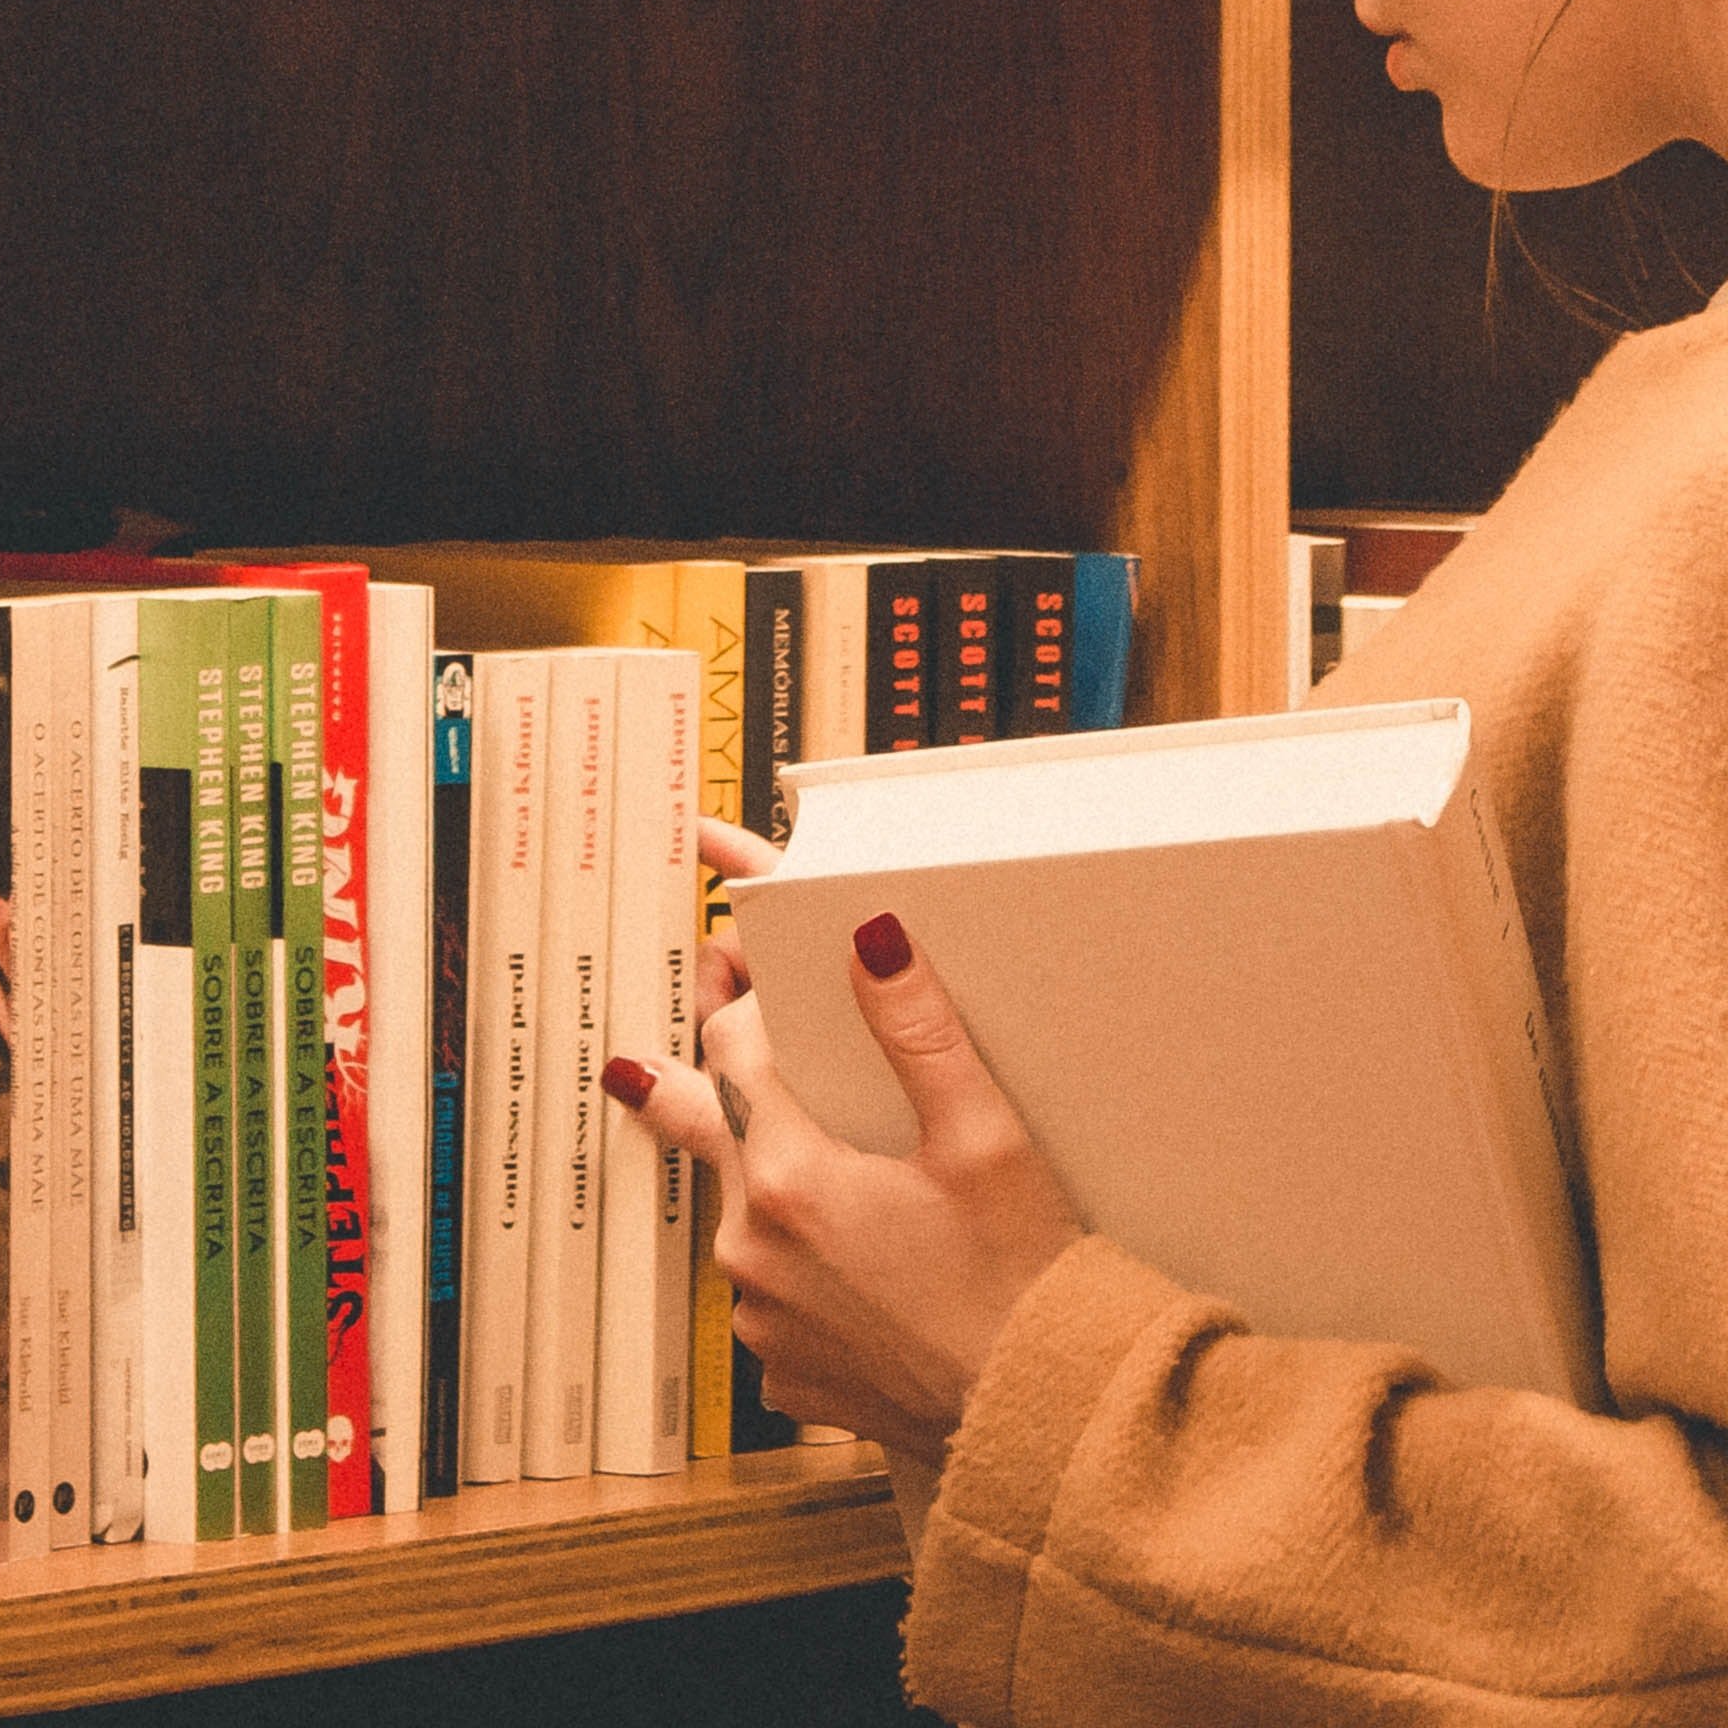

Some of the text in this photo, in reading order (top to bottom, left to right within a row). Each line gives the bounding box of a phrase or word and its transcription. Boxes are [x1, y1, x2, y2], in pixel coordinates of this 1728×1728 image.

[773, 607, 790, 763] MEMÓRIAS
[892, 595, 920, 718] SCOTT
[959, 592, 987, 713] SCOTT
[198, 668, 225, 894] STEPHEN KING
[709, 616, 742, 825] AMYR
[34, 755, 46, 865] ACERTO
[34, 879, 46, 905] DE
[34, 915, 46, 1030] CONTAS
[33, 1037, 44, 1067] DE
[33, 1079, 44, 1143] UMA
[202, 954, 225, 1260] SOBRE A ESCRITA
